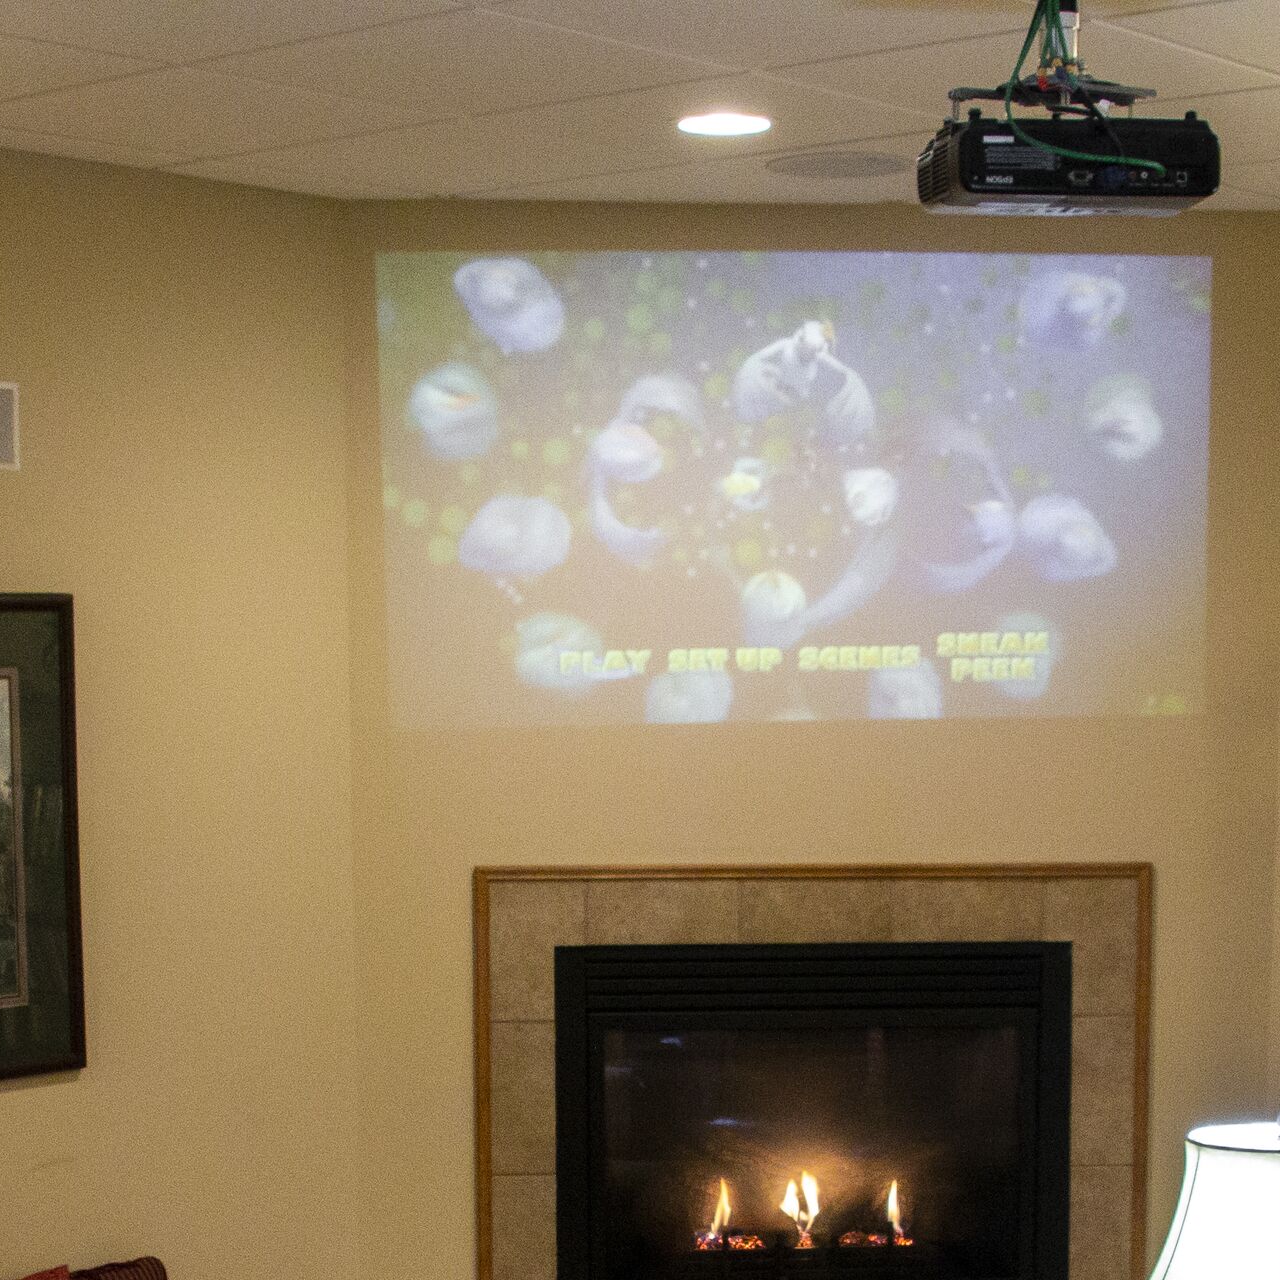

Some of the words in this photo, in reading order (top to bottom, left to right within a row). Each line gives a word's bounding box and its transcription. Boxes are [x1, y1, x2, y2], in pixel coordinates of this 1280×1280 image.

[986, 176, 1013, 184] EPSON
[559, 649, 651, 674] PLAY
[667, 647, 729, 672] SET
[735, 646, 783, 671] UP
[798, 644, 920, 670] SCENES
[950, 656, 1035, 682] PEEK
